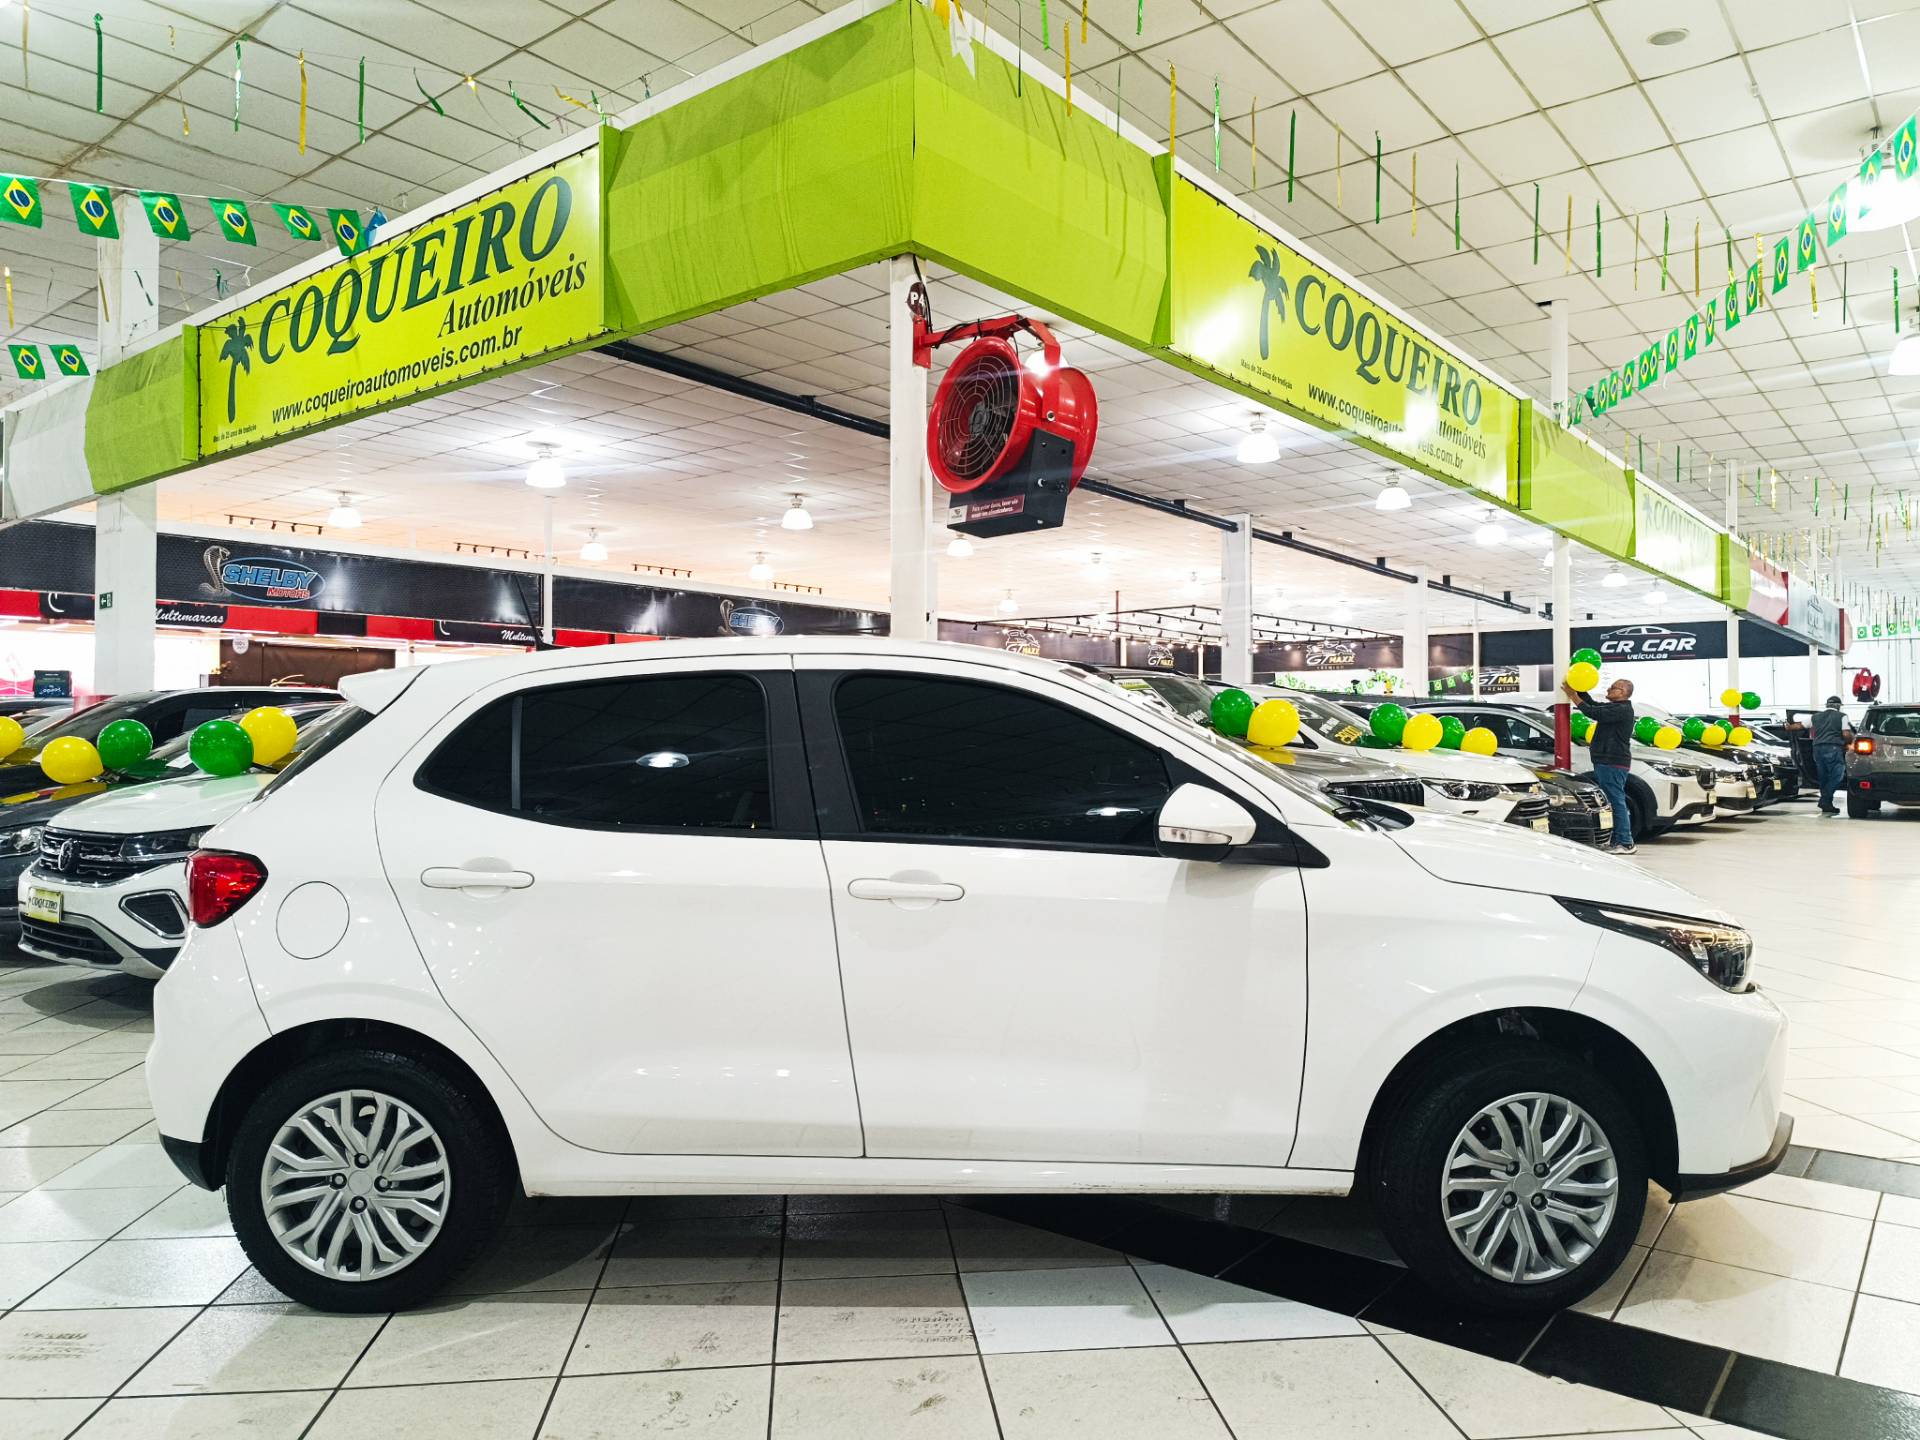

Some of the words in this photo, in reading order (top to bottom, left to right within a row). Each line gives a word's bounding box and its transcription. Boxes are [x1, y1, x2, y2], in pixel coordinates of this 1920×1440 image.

[259, 175, 572, 364] COQUEIRO
[437, 253, 588, 338] Automóveis
[271, 325, 524, 424] www.coqueiroautomoveis.com.br
[1294, 274, 1482, 426] COQUEIRO
[1434, 416, 1487, 460] utomóveis
[222, 563, 319, 589] SHELBY
[266, 587, 311, 599] MOTORS
[1600, 640, 1635, 654] CR
[1641, 637, 1697, 652] CAR
